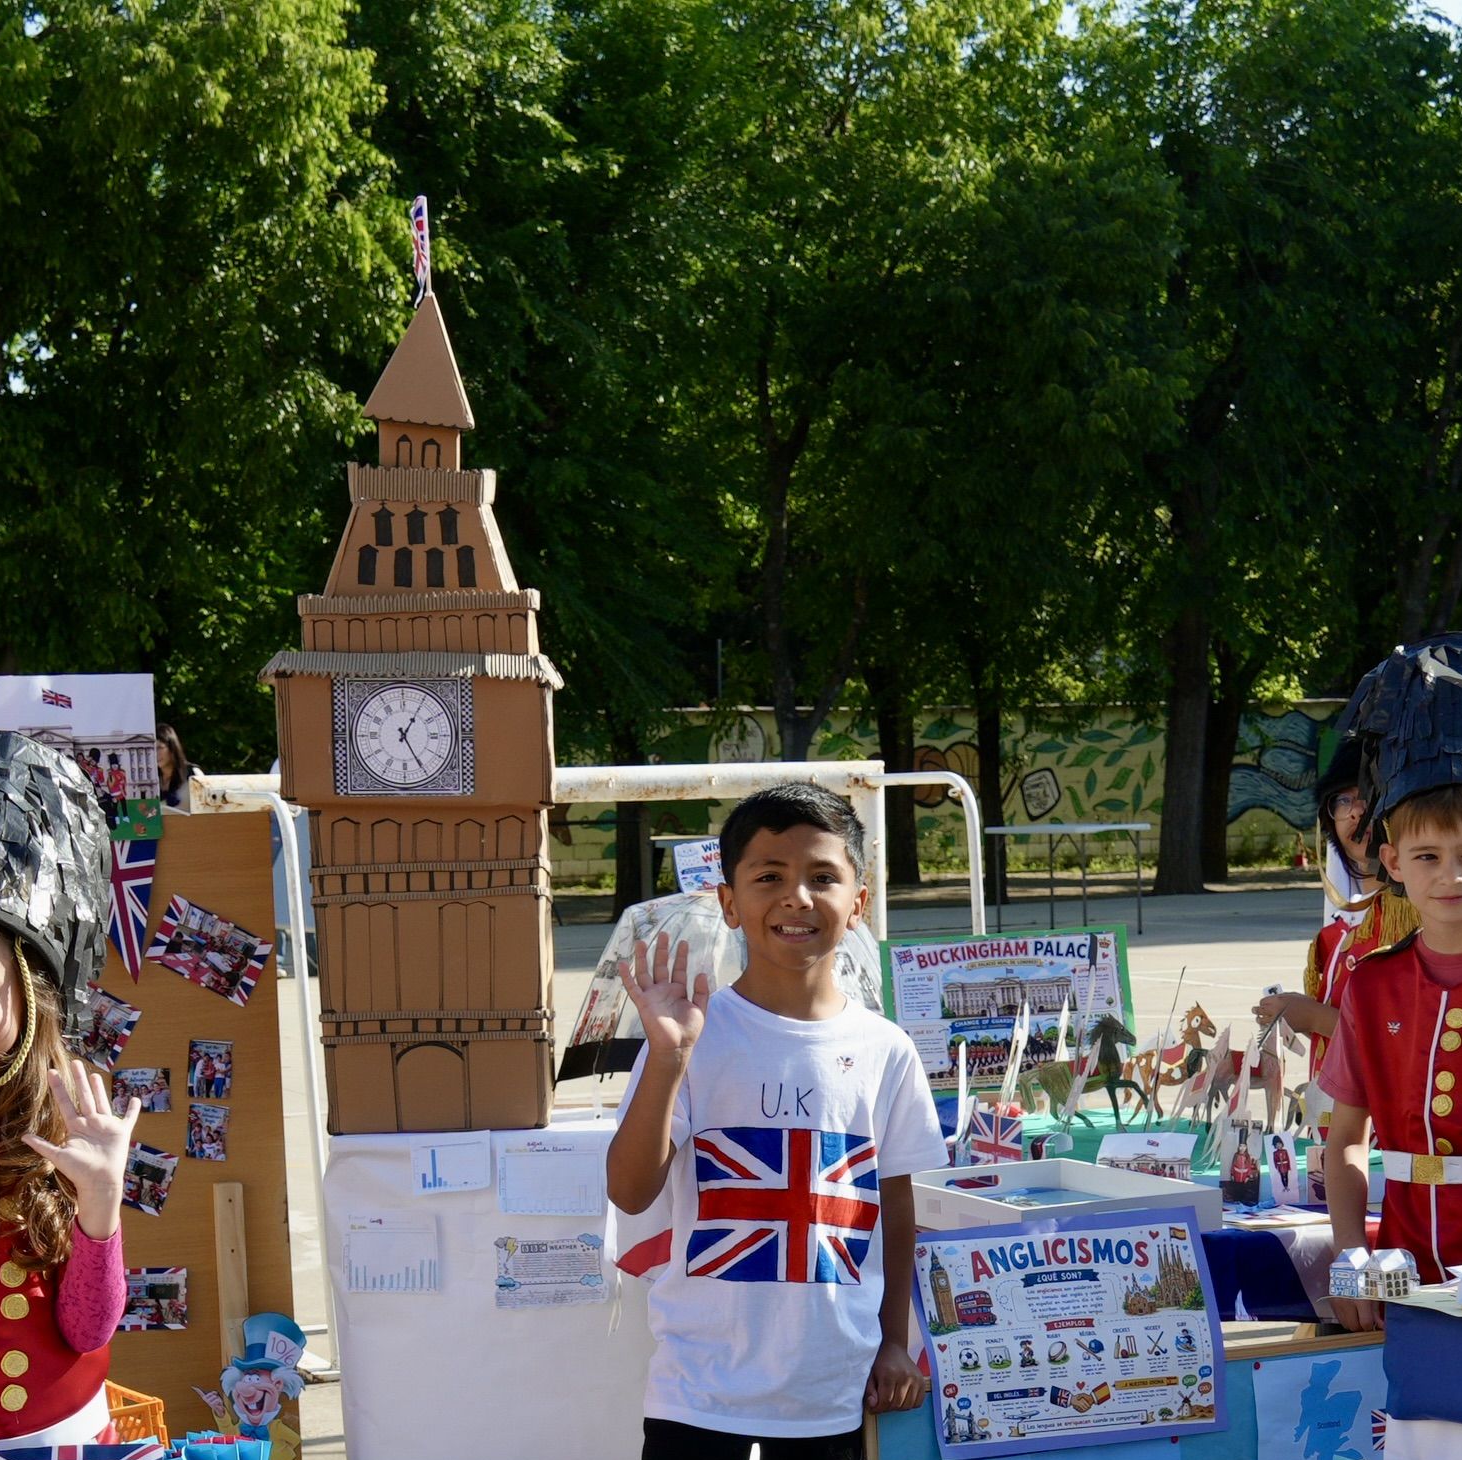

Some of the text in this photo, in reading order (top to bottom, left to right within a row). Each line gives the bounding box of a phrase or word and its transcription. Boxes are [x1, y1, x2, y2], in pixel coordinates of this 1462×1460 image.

[917, 940, 1090, 969] BUCKINGHAM PALAC
[971, 1238, 1149, 1282] ANGLICISMOS
[1037, 1272, 1082, 1283] ¿QUÉ SON?
[1054, 1321, 1086, 1329] EJEMPLOS
